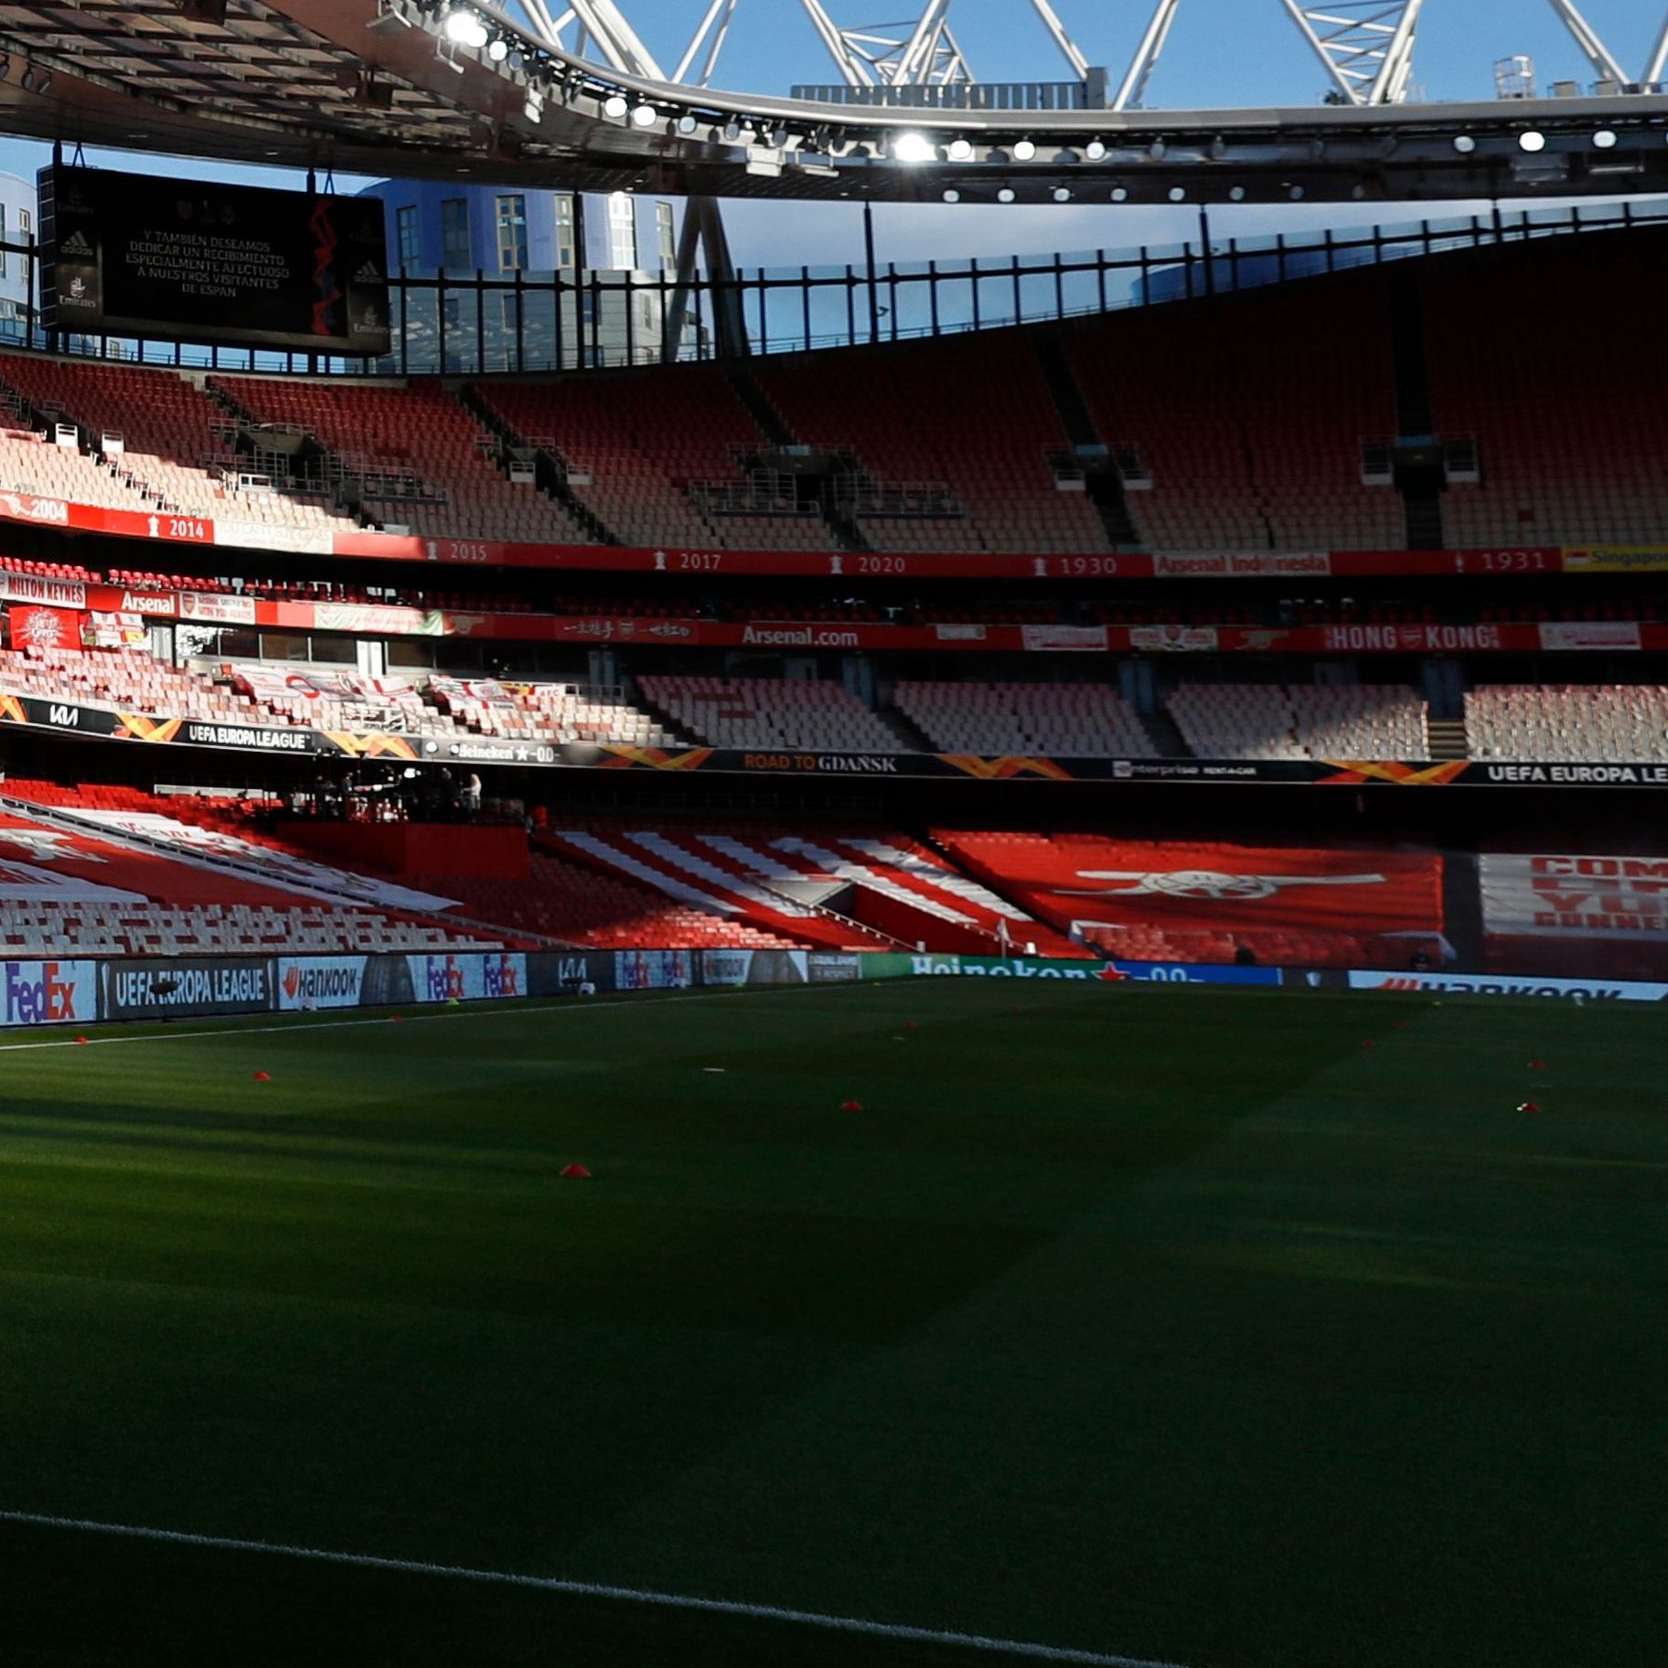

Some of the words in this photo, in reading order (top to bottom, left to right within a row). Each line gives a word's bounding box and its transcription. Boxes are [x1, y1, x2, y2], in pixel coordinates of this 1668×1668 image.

[130, 241, 180, 256] DEDICAR
[184, 247, 200, 258] UN
[204, 249, 285, 266] RECIBIMIENTO
[211, 237, 271, 252] DESEAMOS
[126, 253, 219, 272] ESPECIALMENTE
[222, 262, 290, 279] AFECTUOSO
[149, 268, 209, 284] NUESTROS
[213, 274, 279, 290] VISITANTES
[182, 283, 198, 294] DE
[30, 499, 65, 522] 2004
[169, 519, 204, 539] 2014
[450, 543, 487, 561] 2015
[680, 553, 722, 570] 2017
[1480, 551, 1546, 570] 1931
[858, 556, 906, 574] 2020
[1060, 557, 1118, 574] 1930
[1158, 556, 1226, 573] Arsenal
[7, 575, 44, 596] MILTON
[46, 581, 84, 603] KEYNES
[120, 591, 176, 615] Arsenal
[742, 625, 859, 648] Arsenal.com
[1332, 626, 1398, 649] HONG
[1426, 625, 1489, 649] KONG
[189, 725, 216, 742] UEFA
[217, 726, 256, 746] EUROPA
[257, 729, 306, 749] LEAGUE
[745, 753, 795, 770] ROAD
[799, 754, 815, 770] TO
[819, 753, 897, 773] GDAŃSK
[1489, 764, 1548, 782] UEFA
[1564, 765, 1636, 783] EUROPA
[427, 955, 464, 1000] FedEx
[483, 954, 517, 998] FedEx
[622, 951, 650, 986] FedEx
[7, 962, 77, 1024] FedEx
[116, 971, 155, 1009] UEFA
[214, 967, 264, 1002] LEAGUE
